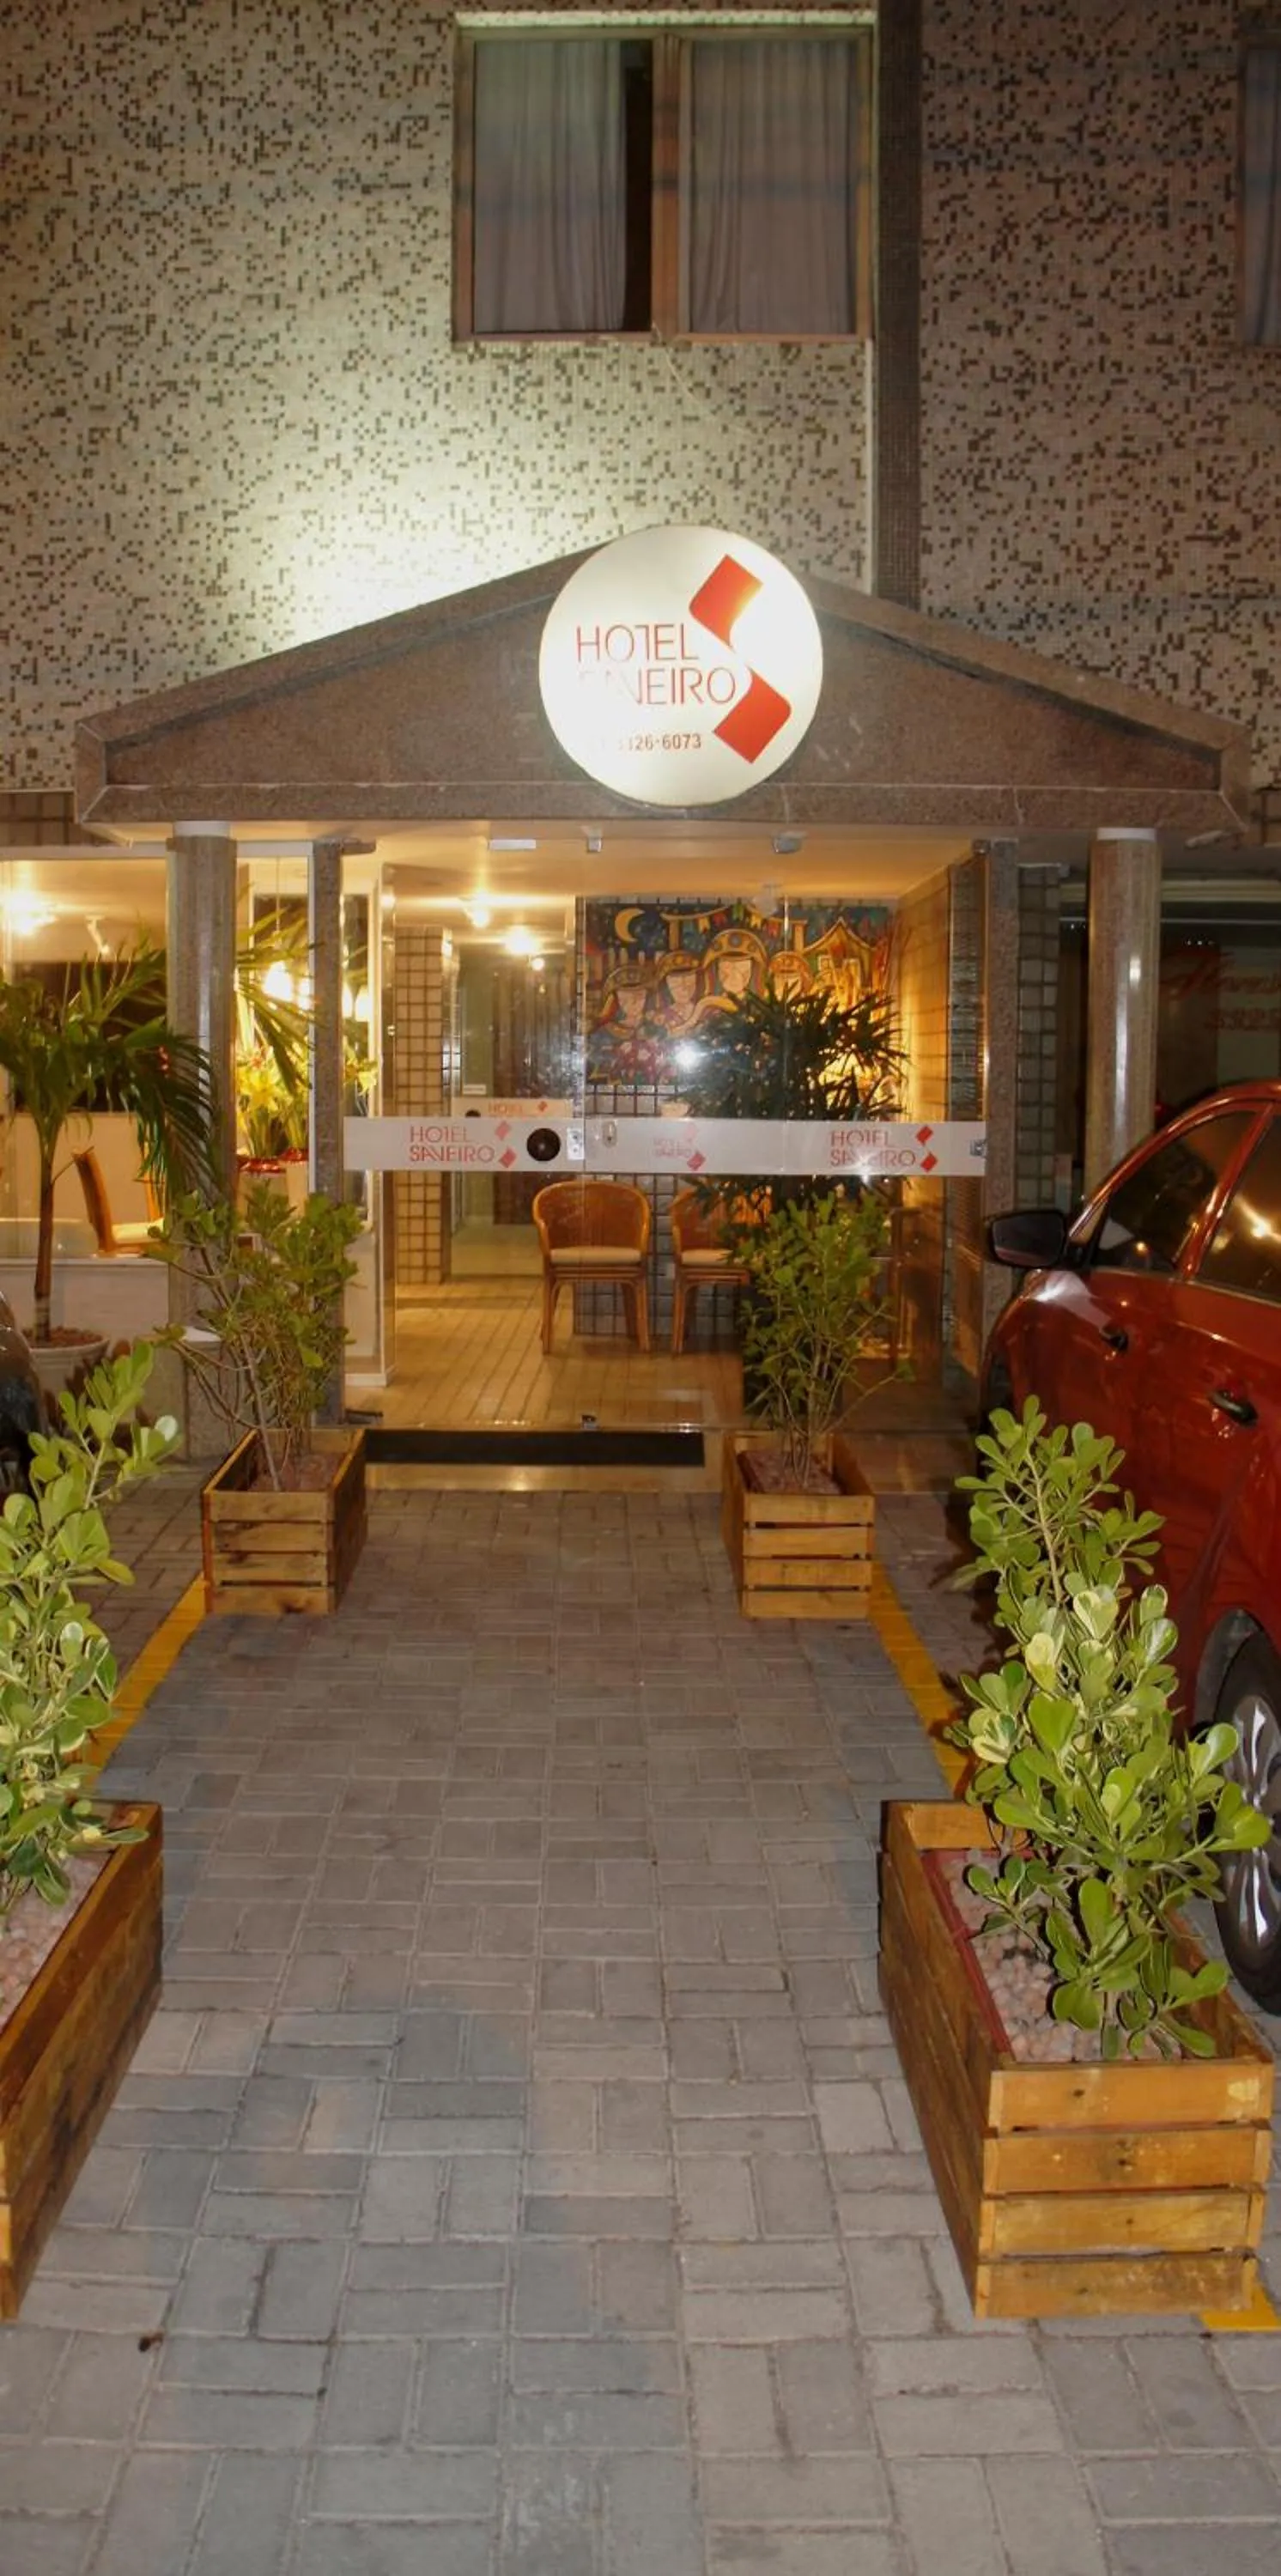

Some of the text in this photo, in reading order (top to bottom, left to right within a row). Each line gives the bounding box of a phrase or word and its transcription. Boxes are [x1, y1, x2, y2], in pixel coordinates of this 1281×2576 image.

[576, 623, 699, 662] HOTEL
[410, 1126, 473, 1143] HOTEL
[829, 1130, 895, 1147] HOTEL
